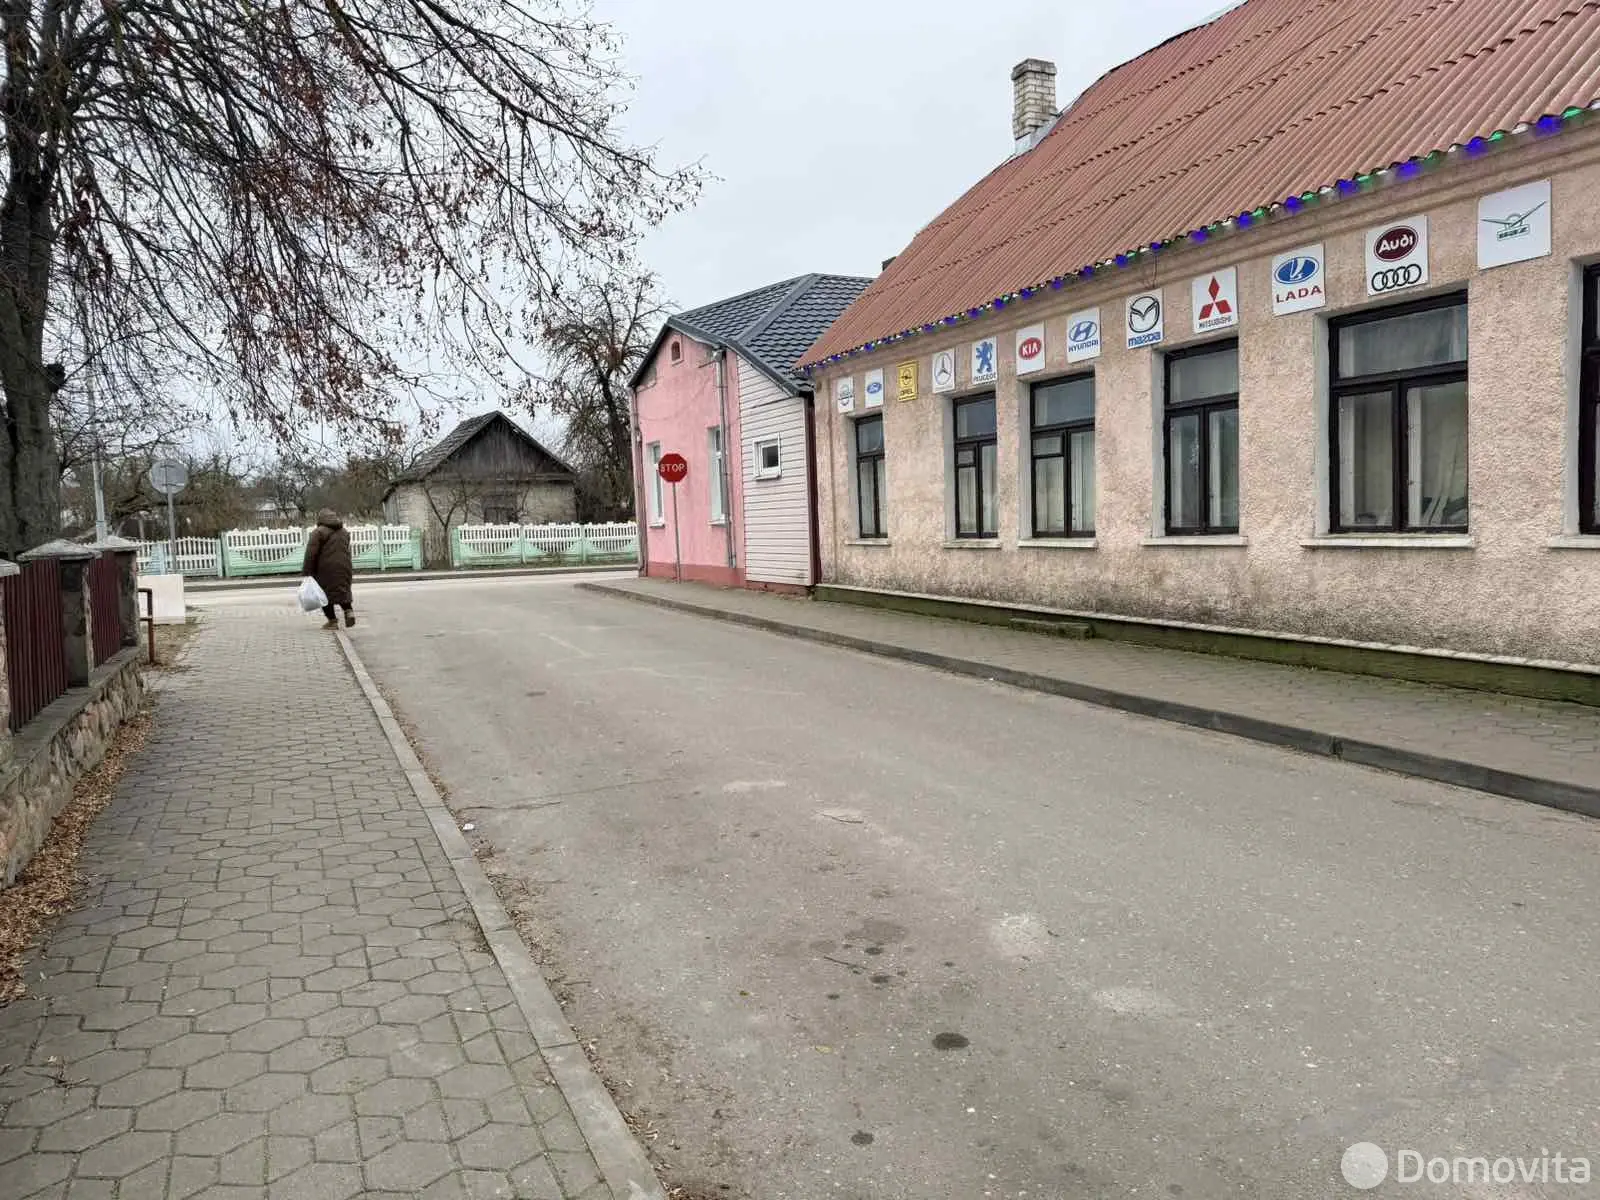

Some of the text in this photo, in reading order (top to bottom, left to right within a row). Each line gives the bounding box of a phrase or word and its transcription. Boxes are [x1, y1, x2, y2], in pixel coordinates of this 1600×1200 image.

[1377, 232, 1414, 255] Audi
[1276, 285, 1322, 303] LADA
[1128, 332, 1161, 347] mazda
[1021, 342, 1038, 357] KIA
[660, 463, 685, 472] STOP
